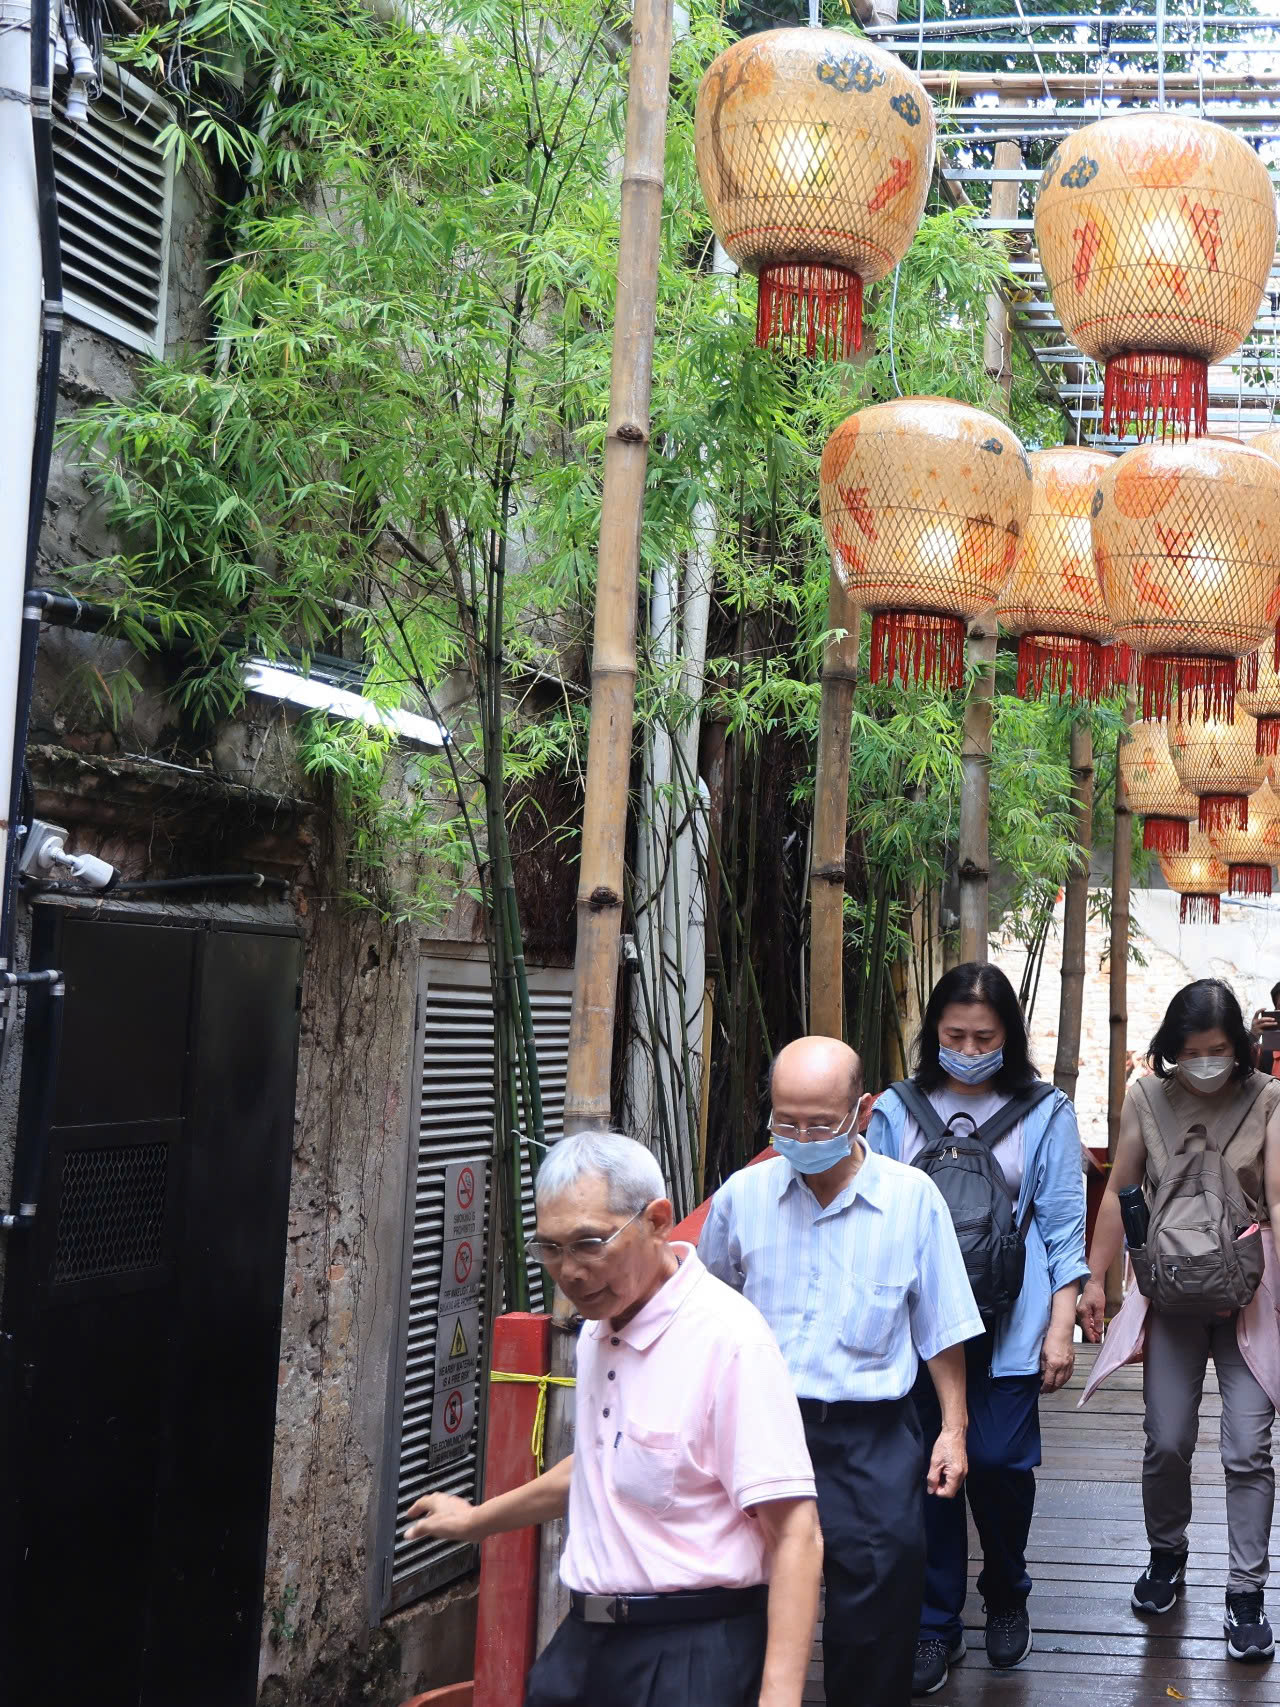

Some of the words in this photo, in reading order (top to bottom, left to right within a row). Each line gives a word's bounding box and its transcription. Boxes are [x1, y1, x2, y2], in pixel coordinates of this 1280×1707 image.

[439, 1365, 455, 1377] NEARBY
[456, 1358, 475, 1371] MATERIAL
[452, 1374, 460, 1384] FIRE
[461, 1371, 470, 1381] RISK
